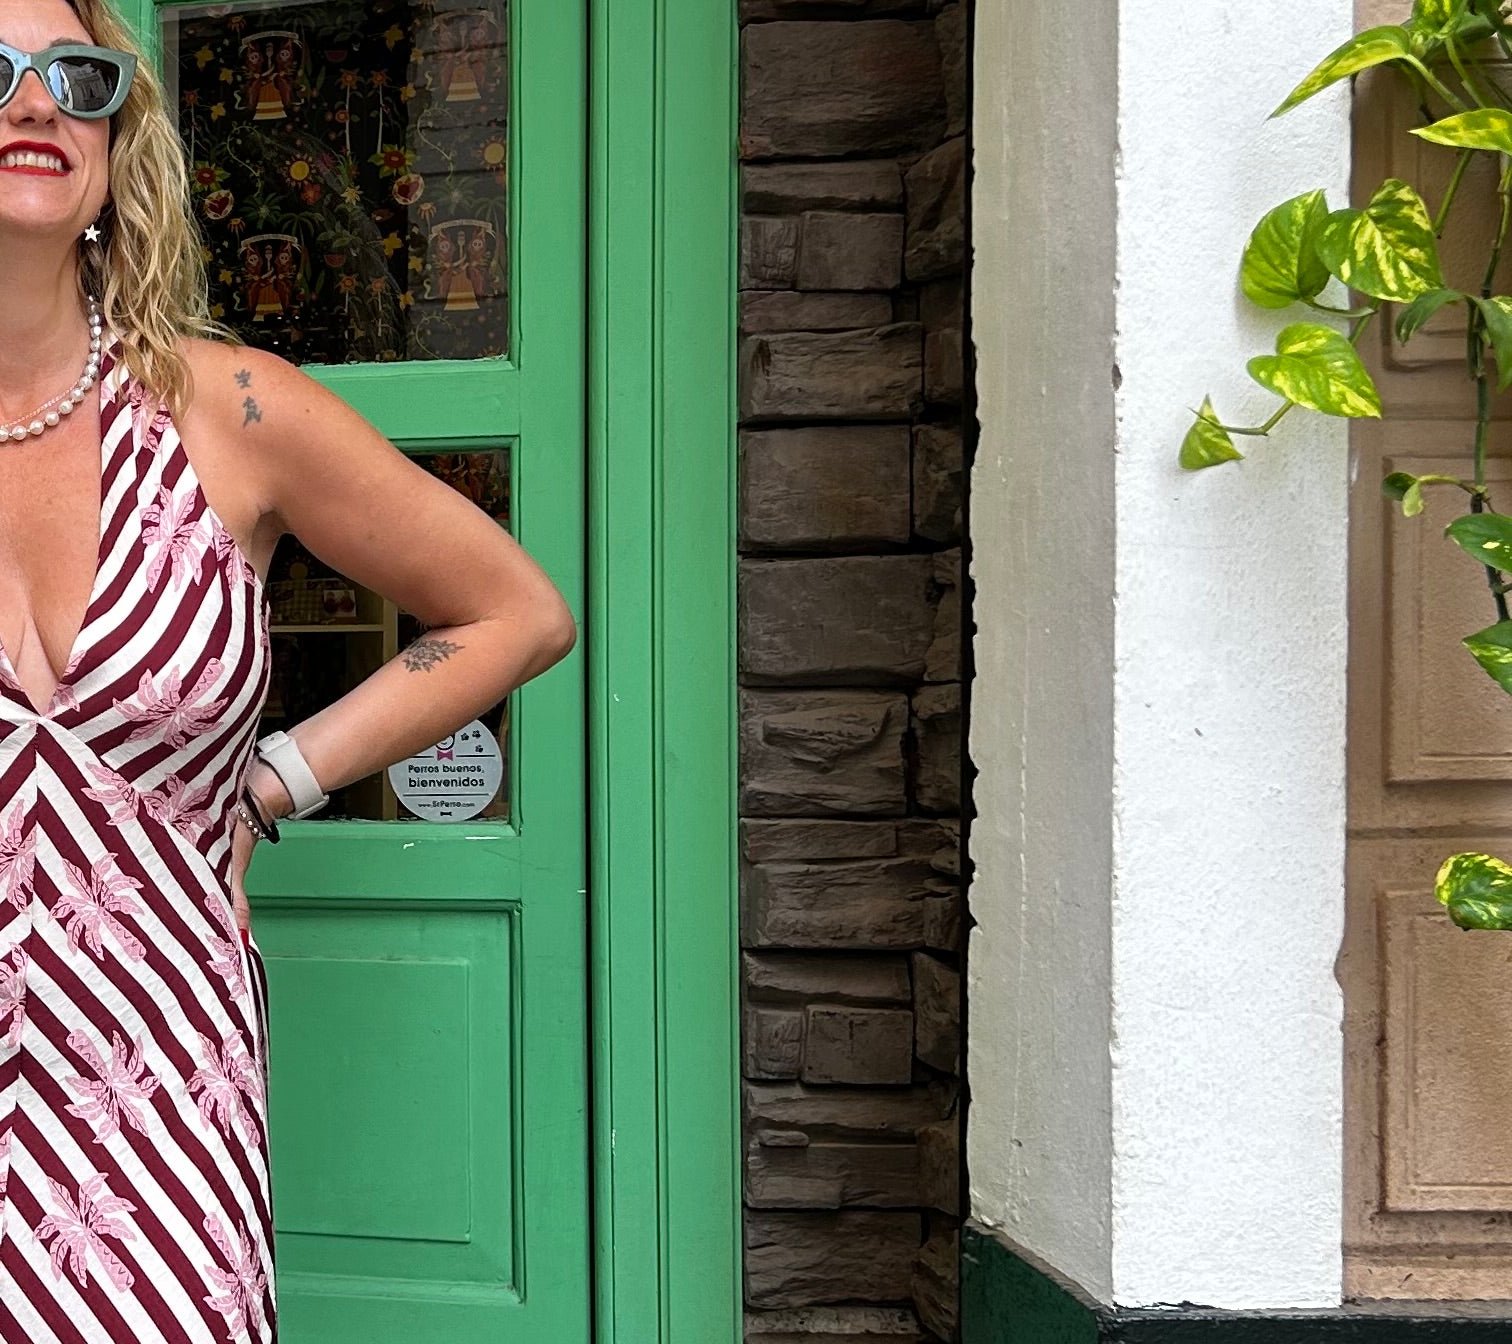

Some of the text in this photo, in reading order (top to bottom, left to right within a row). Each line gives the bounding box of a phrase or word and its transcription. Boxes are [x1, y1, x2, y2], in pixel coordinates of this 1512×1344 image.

[408, 764, 485, 774] Perros buenos,
[408, 777, 485, 787] bienvenidos
